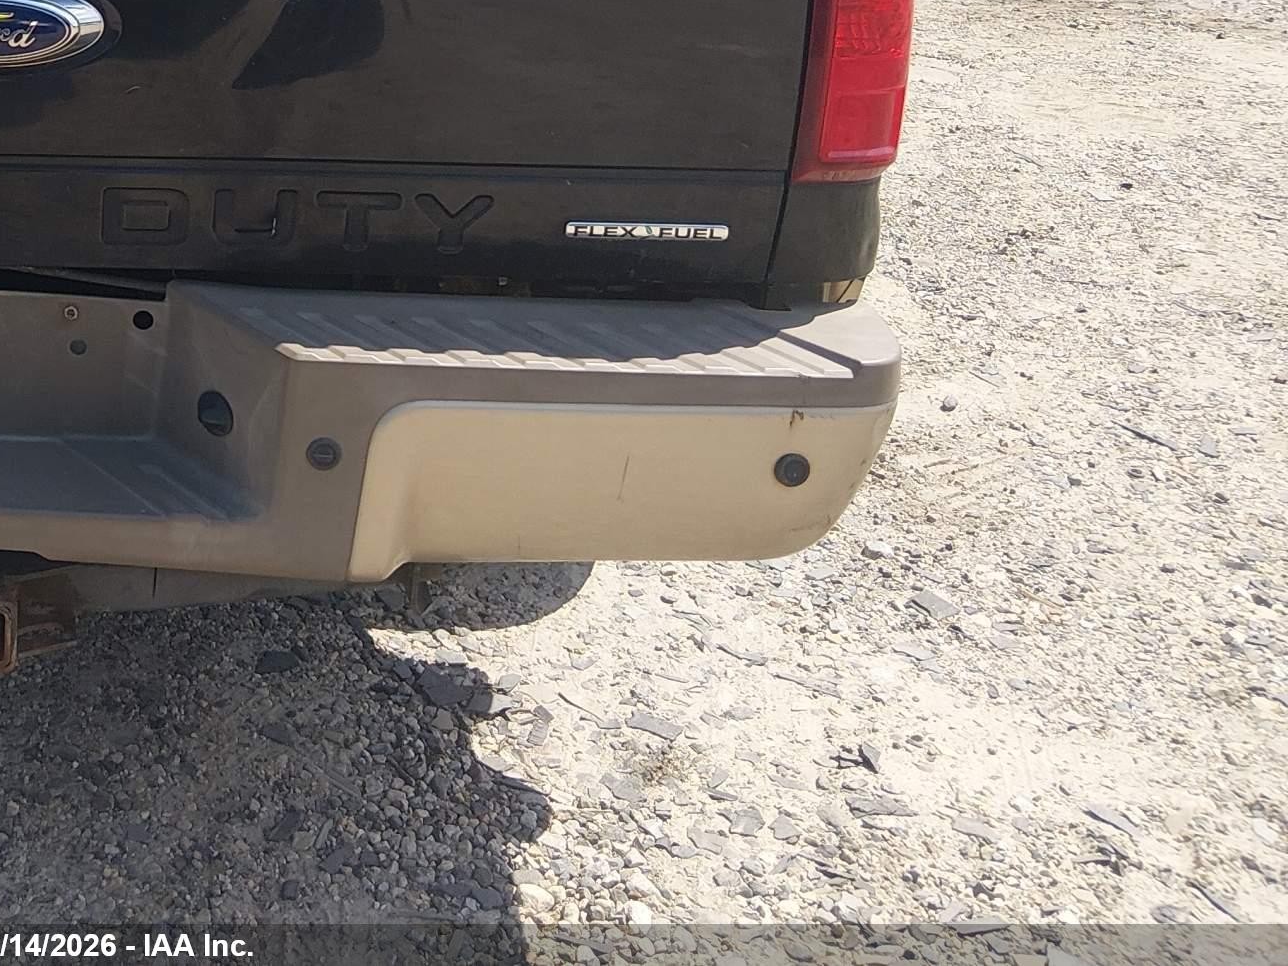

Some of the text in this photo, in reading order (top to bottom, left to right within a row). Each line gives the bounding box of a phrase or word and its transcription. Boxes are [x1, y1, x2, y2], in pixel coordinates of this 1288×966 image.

[99, 184, 498, 256] DUTY
[573, 225, 724, 240] FLEX FUEL
